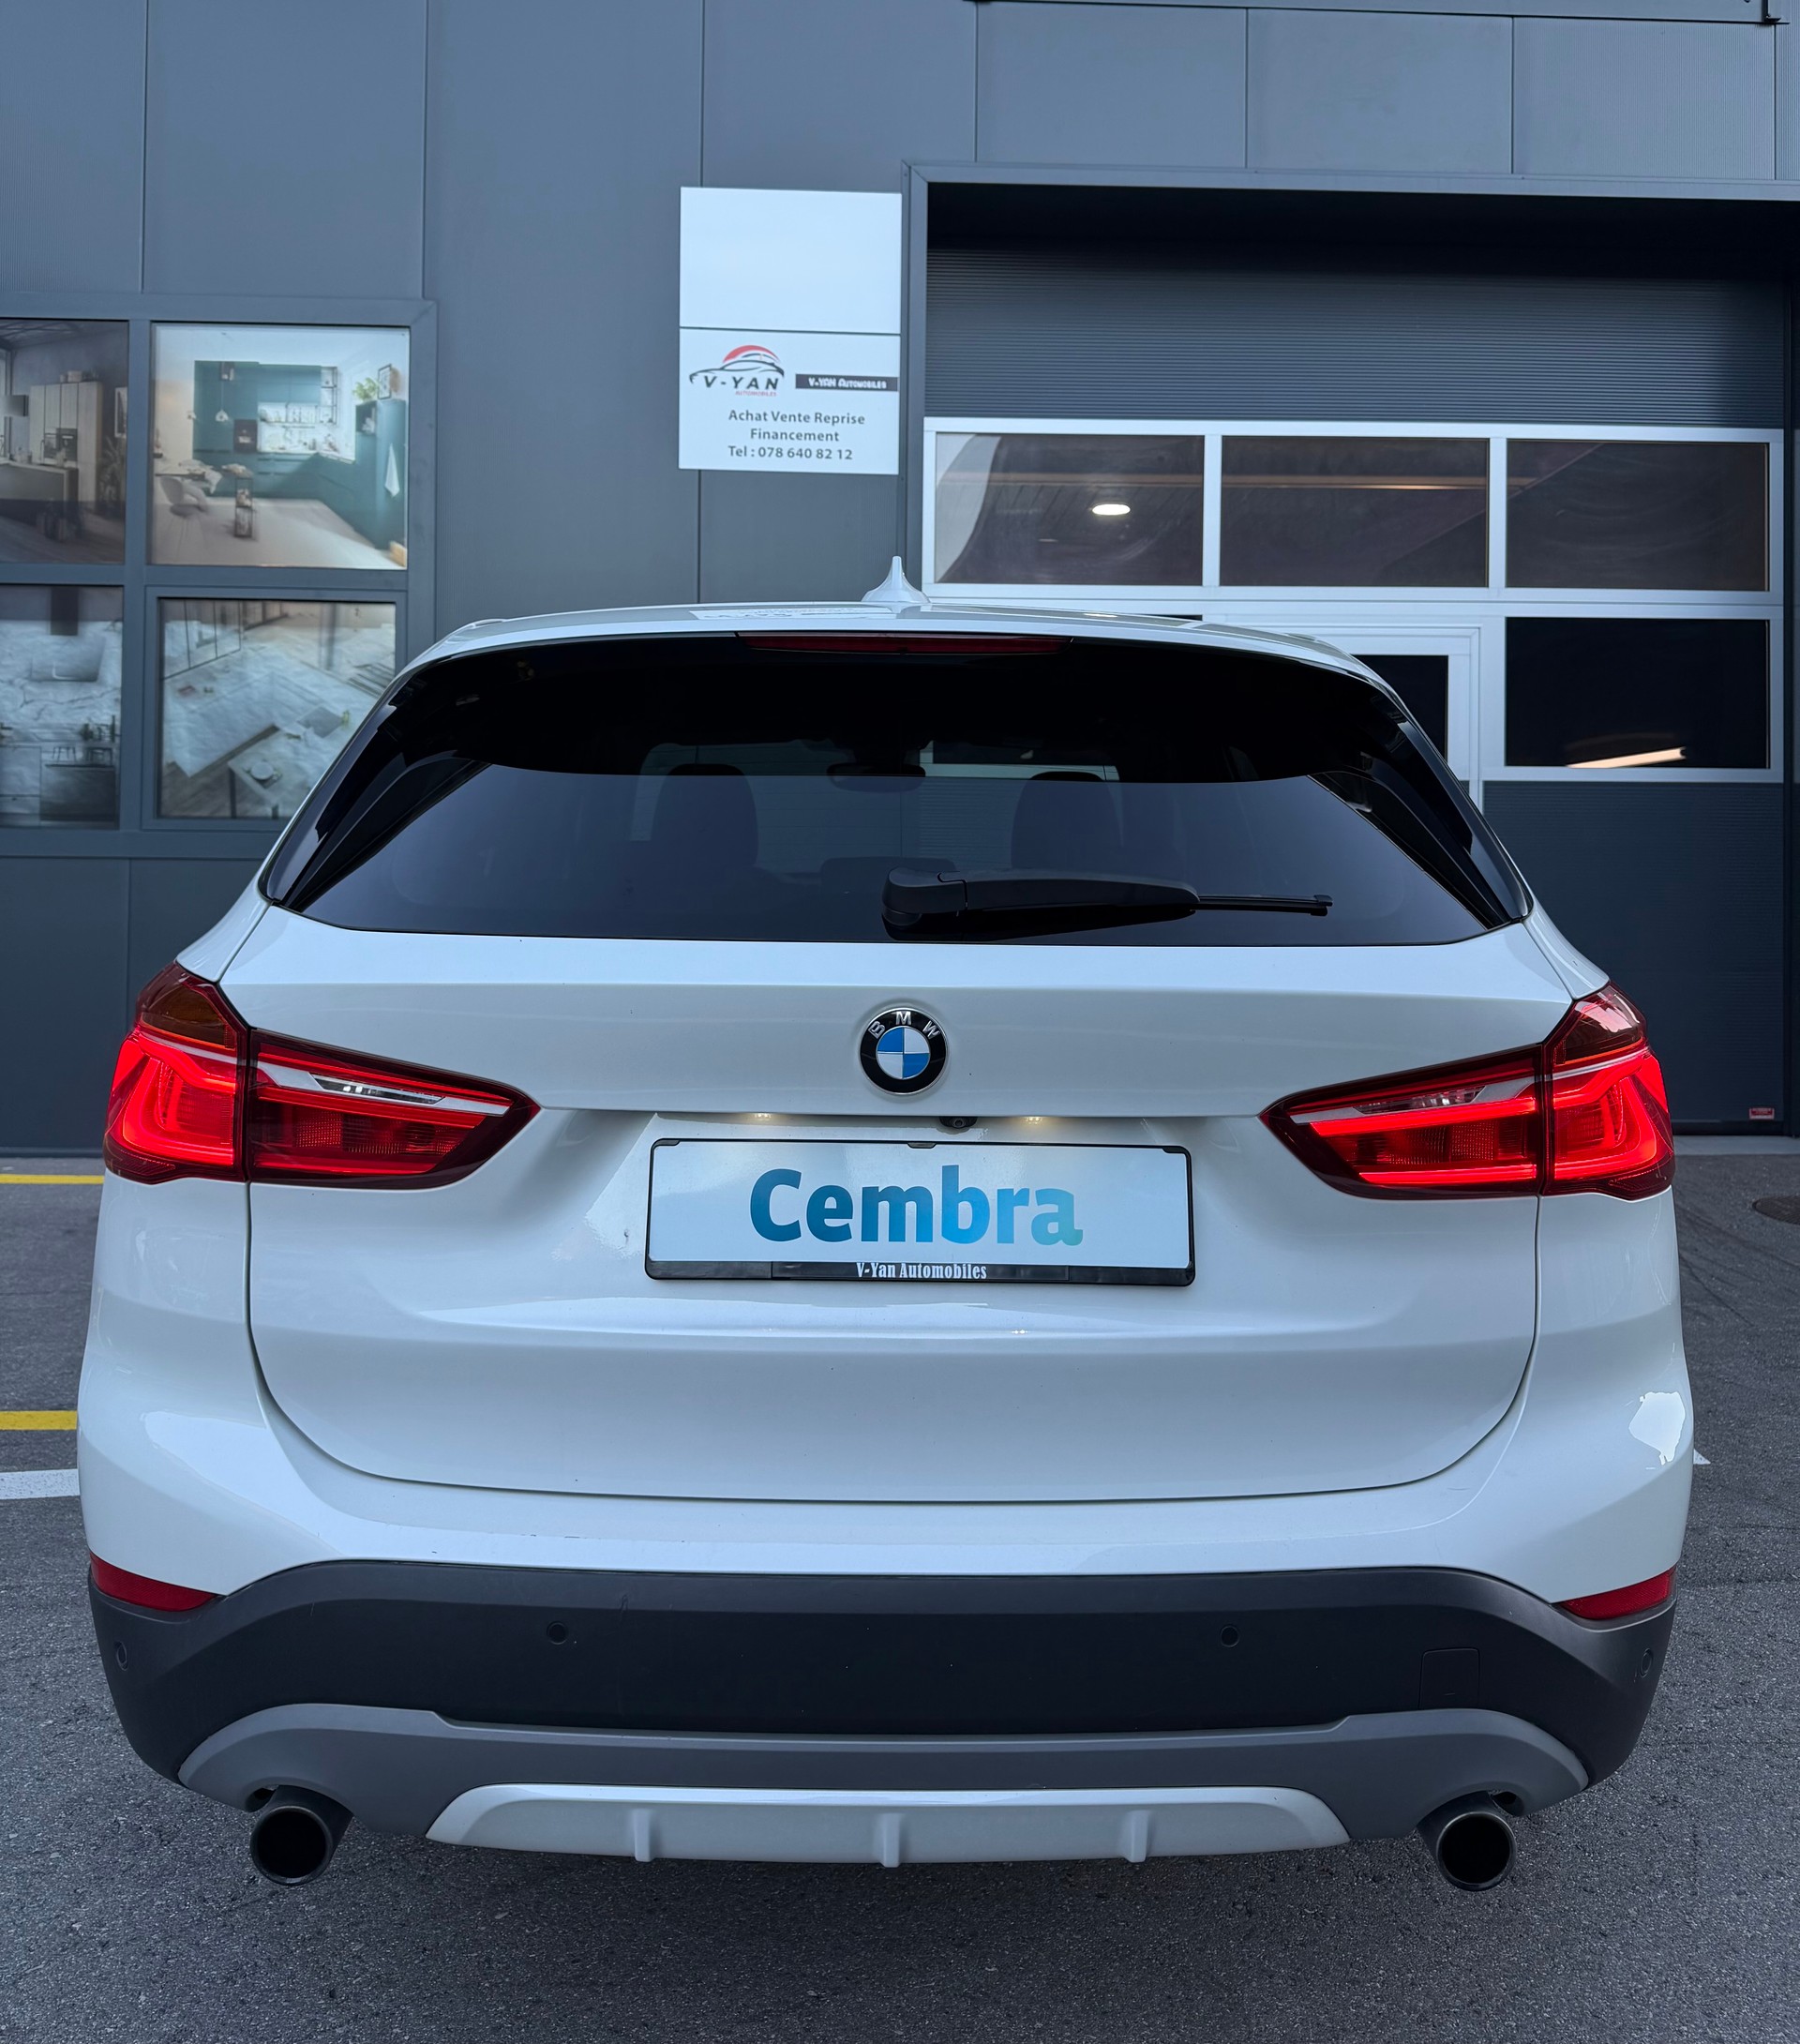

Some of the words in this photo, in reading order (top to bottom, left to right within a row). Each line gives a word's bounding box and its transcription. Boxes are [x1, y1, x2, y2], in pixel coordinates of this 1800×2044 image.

[704, 375, 779, 390] V-YAN
[728, 410, 768, 421] Achat
[771, 411, 811, 423] Vente
[814, 412, 865, 426] Reprise
[750, 428, 839, 442] Financement
[758, 446, 784, 458] 078
[787, 447, 813, 458] 640
[816, 448, 832, 459] 82
[837, 449, 853, 459] 12
[867, 1011, 941, 1039] BMW
[750, 1165, 1084, 1246] Cembra
[856, 1262, 896, 1278] V-Yan
[899, 1263, 987, 1279] Automobiles
